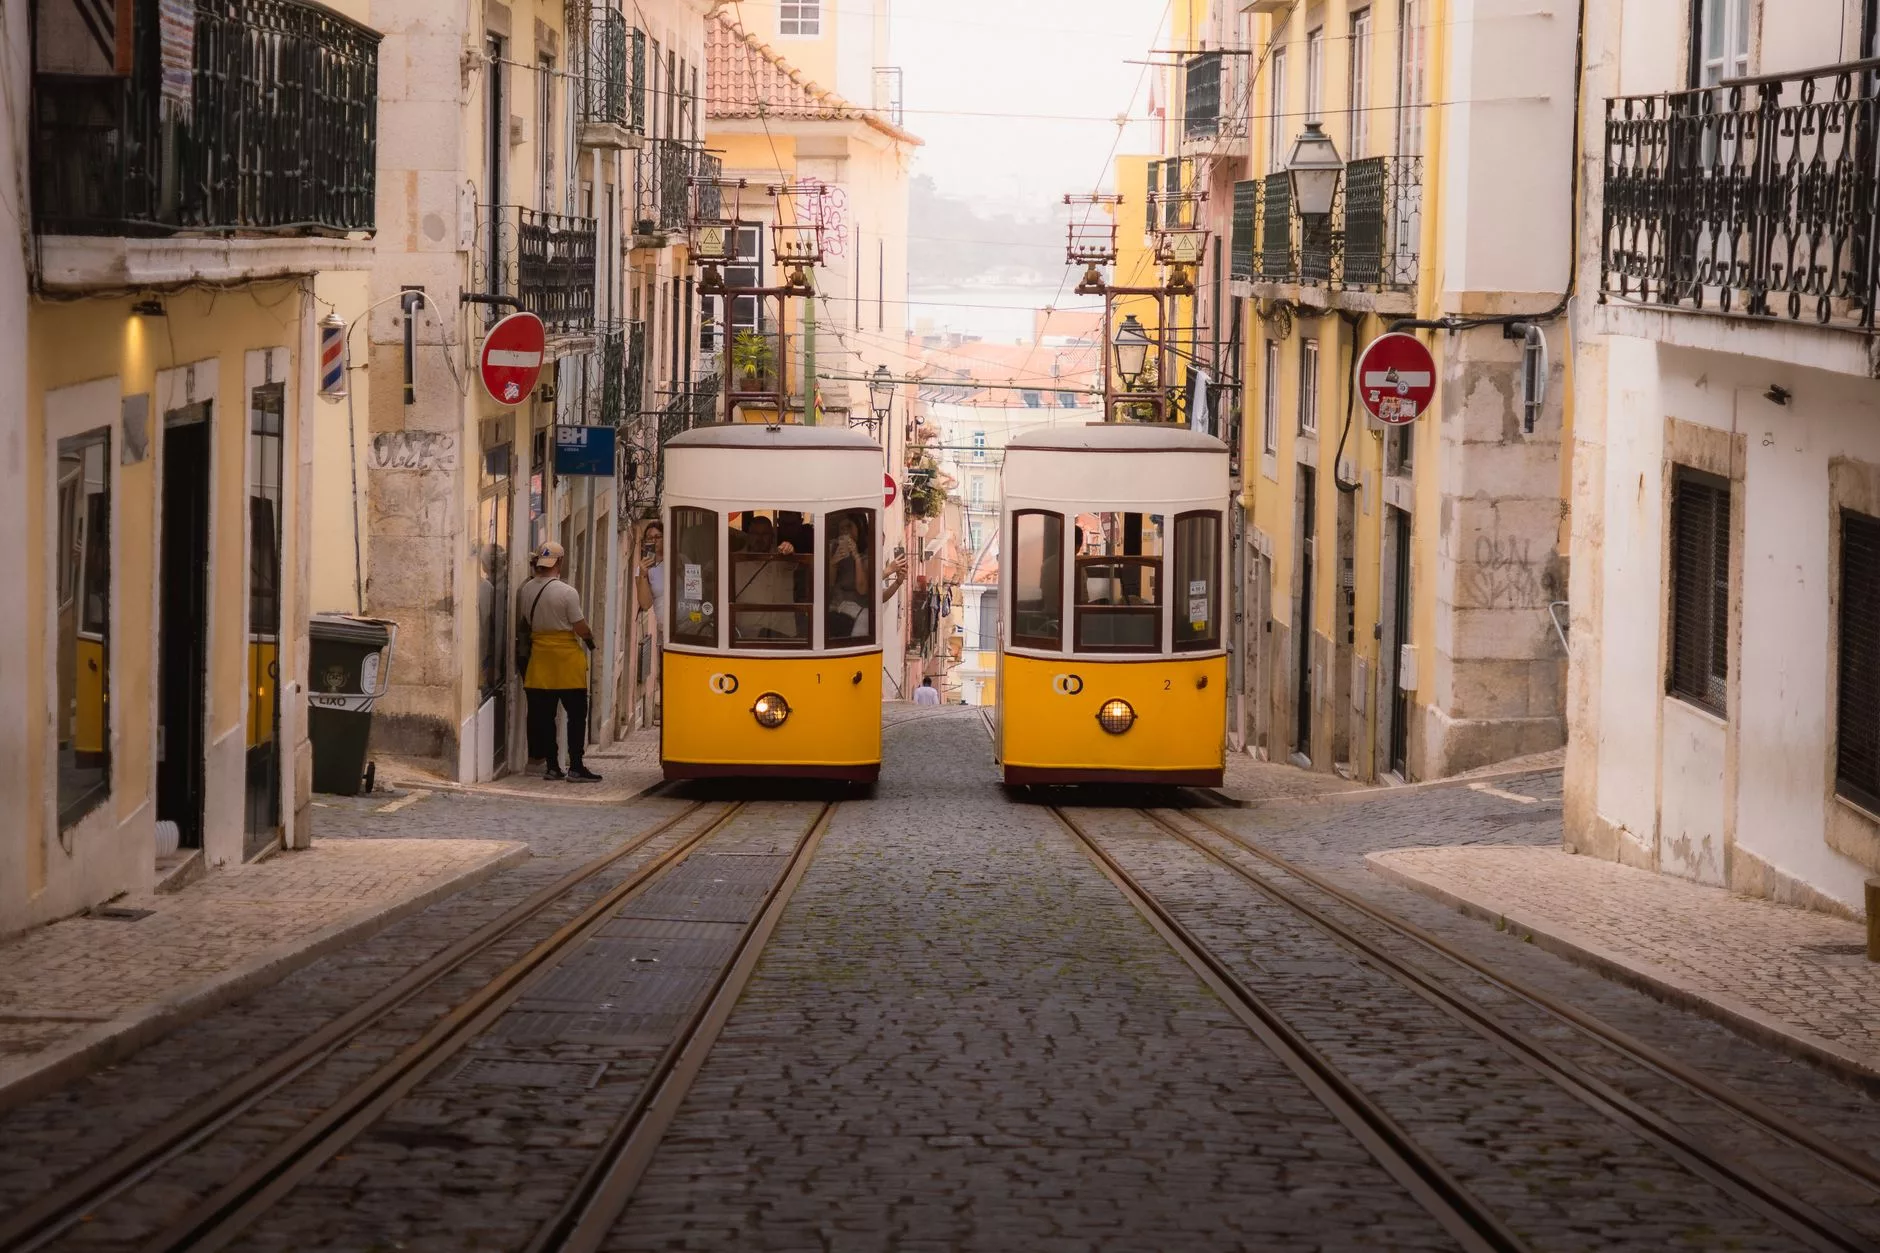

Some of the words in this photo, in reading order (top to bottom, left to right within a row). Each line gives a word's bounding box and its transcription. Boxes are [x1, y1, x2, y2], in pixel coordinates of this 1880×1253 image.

[557, 427, 588, 445] BH
[817, 673, 821, 684] 1
[1163, 679, 1171, 690] 2
[319, 697, 346, 706] LIXO
